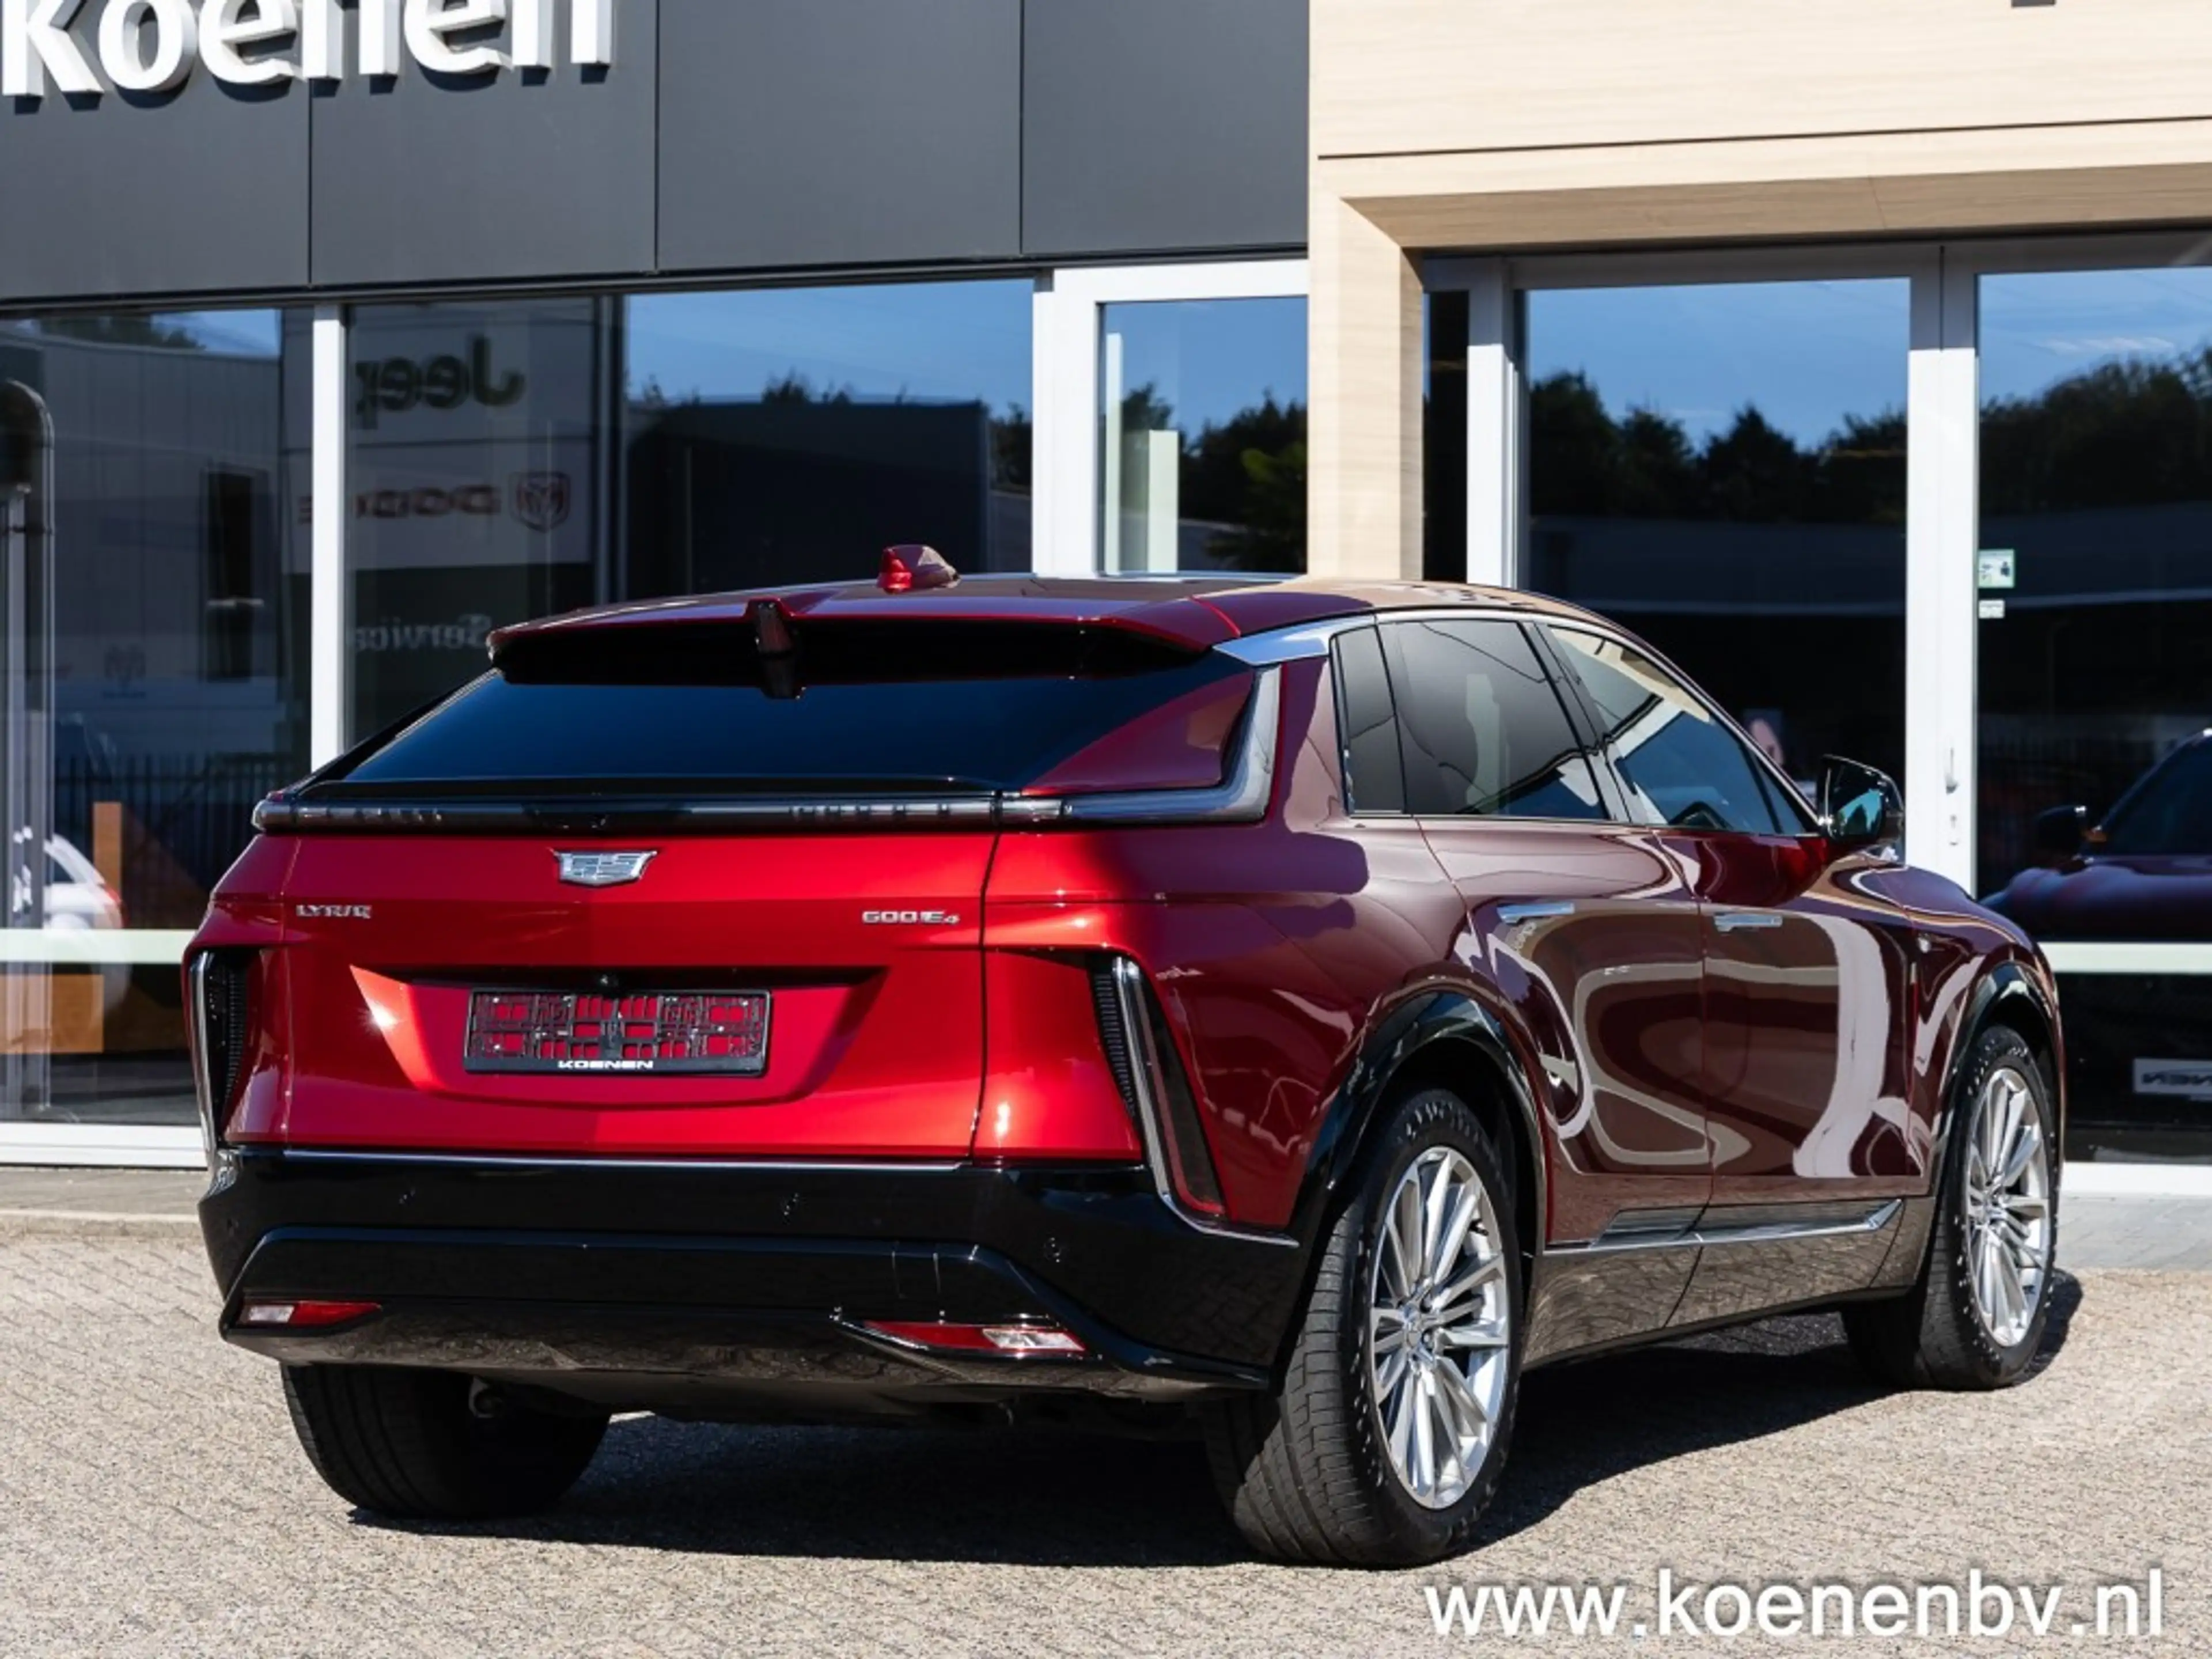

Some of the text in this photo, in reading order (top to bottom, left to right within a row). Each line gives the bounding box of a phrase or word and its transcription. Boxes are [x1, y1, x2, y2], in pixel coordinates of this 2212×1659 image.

[2, 0, 612, 96] koenen
[296, 904, 373, 919] LYRIQ
[558, 1060, 654, 1069] KOENEN
